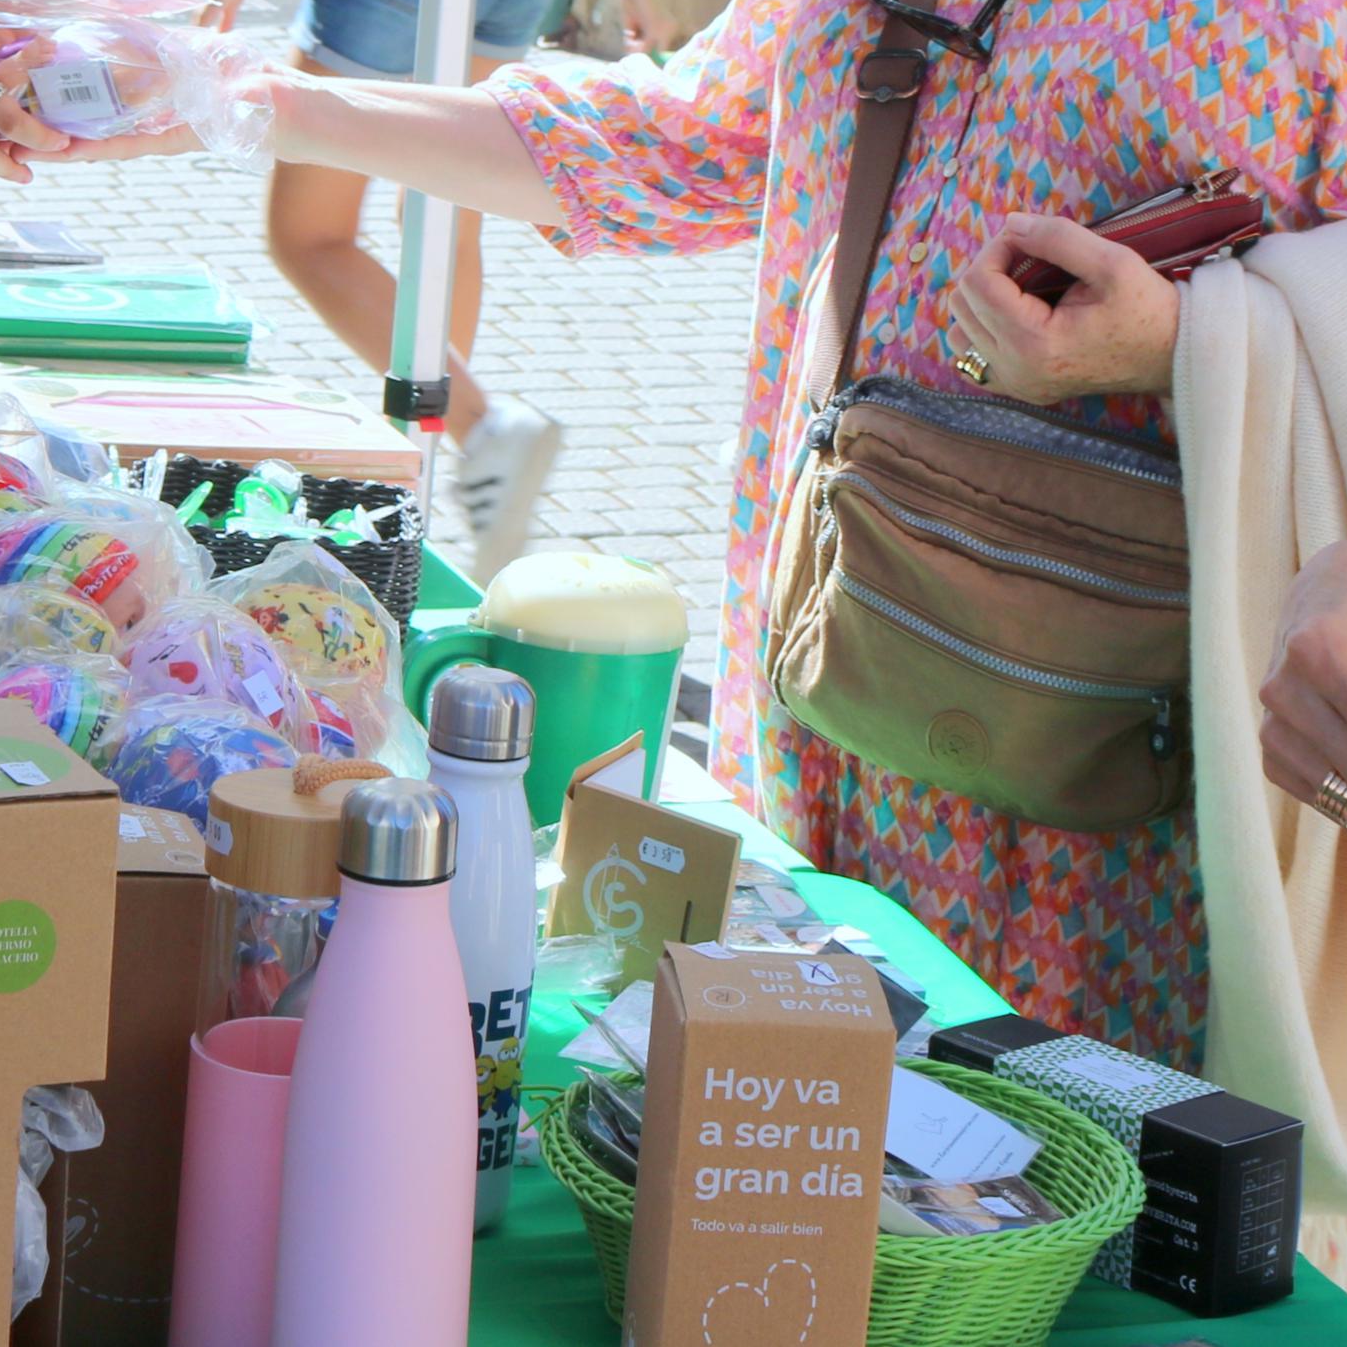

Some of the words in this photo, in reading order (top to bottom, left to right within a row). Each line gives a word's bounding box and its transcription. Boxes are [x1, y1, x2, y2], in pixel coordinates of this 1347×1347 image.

[2, 952, 39, 964] ACERO
[819, 999, 873, 1018] Hoy
[704, 1067, 786, 1112] Hoy
[794, 1078, 841, 1105] va
[699, 1120, 723, 1147] a
[733, 1121, 800, 1149] ser
[809, 1125, 861, 1152] un
[694, 1166, 789, 1200] gran
[801, 1163, 863, 1198] día
[691, 1218, 726, 1232] Todo
[728, 1221, 745, 1233] va
[748, 1223, 757, 1234] a
[760, 1221, 789, 1235] salir
[792, 1222, 824, 1237] bien
